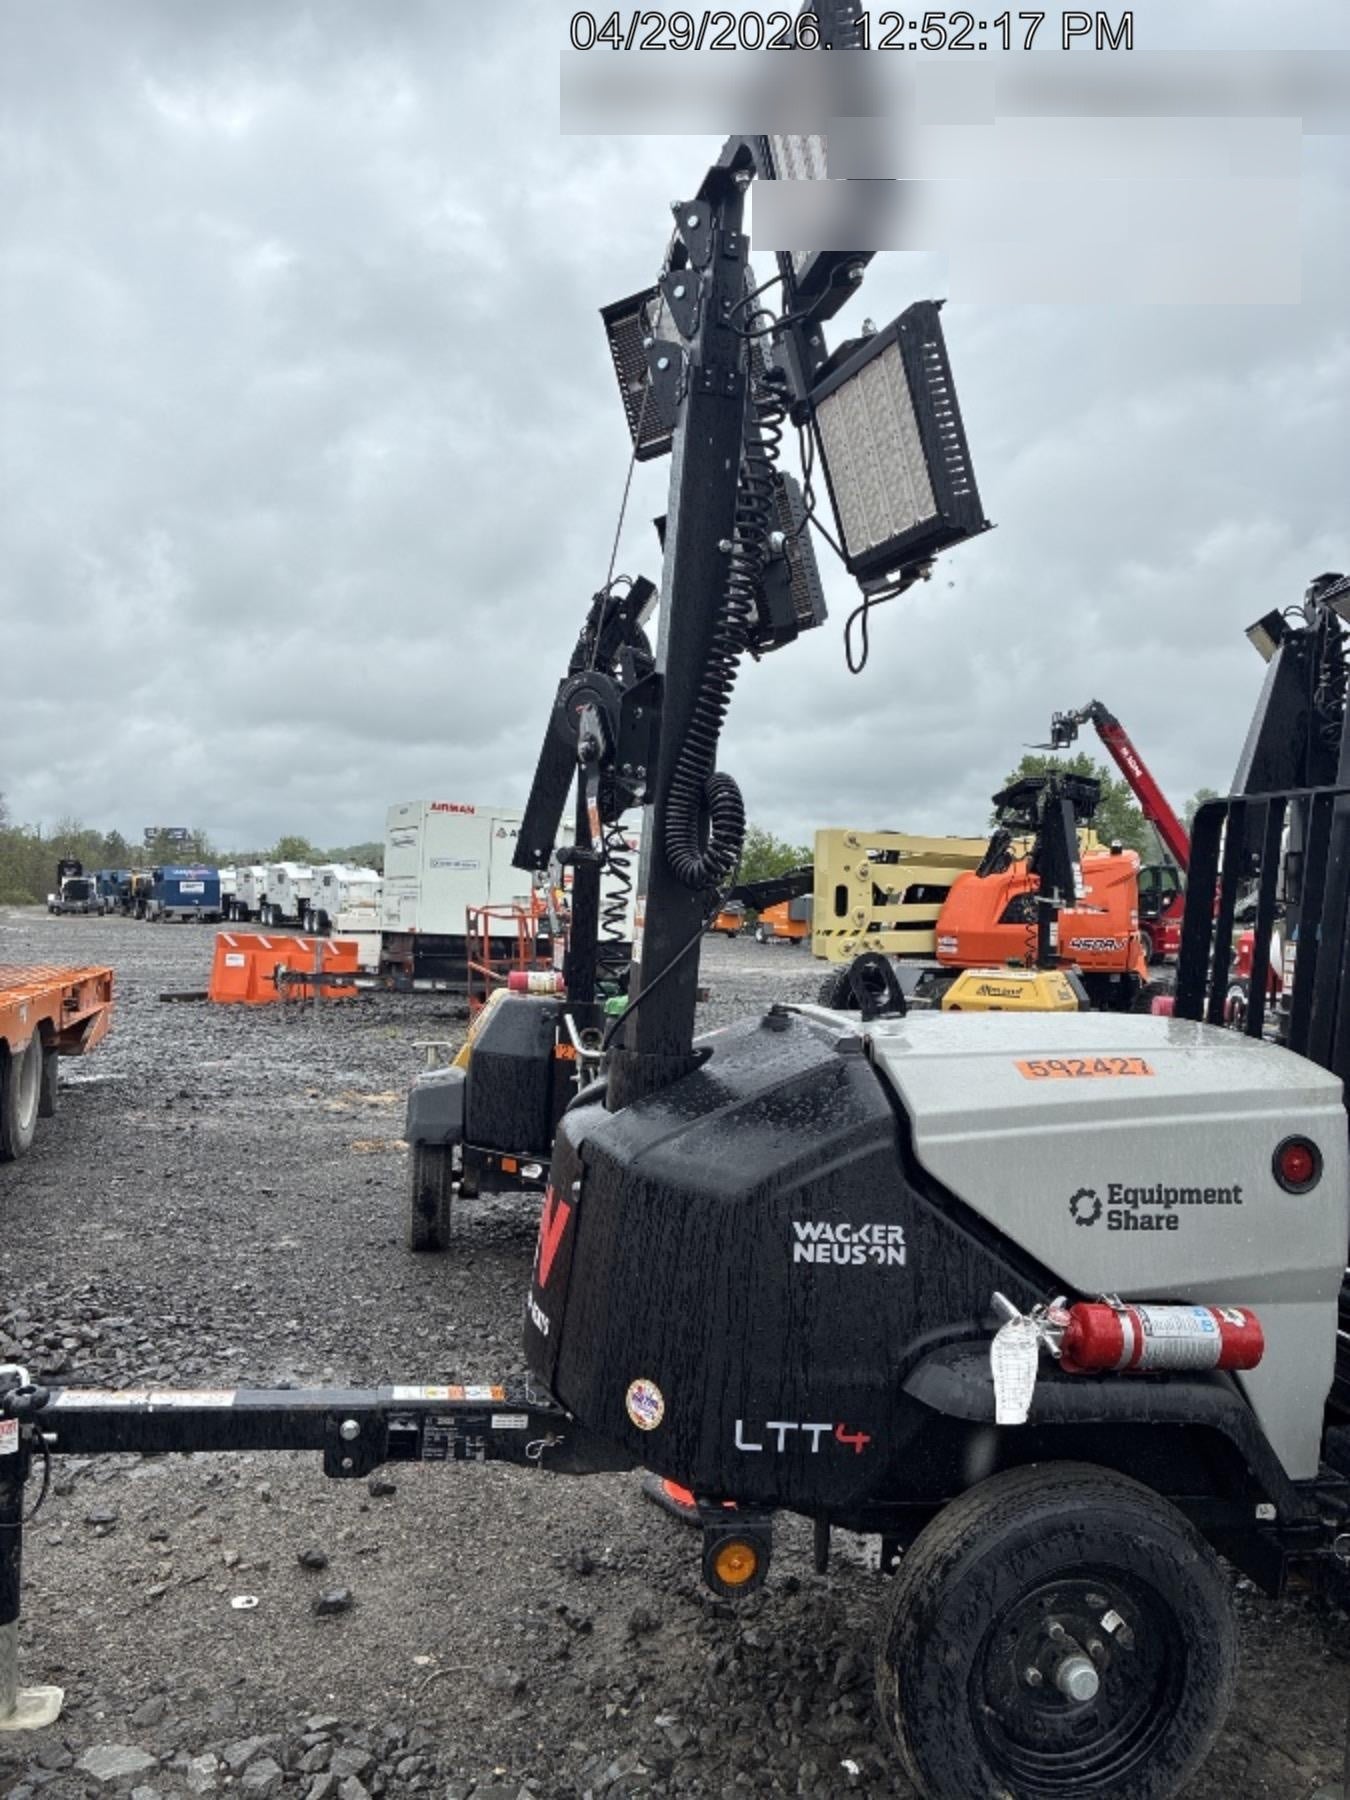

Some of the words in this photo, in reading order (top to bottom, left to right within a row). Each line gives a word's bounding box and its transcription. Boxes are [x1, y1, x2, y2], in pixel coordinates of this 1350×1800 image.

[430, 801, 476, 815] AIRMAN
[1026, 1057, 1151, 1077] 592427
[1107, 1183, 1243, 1209] Equipment
[1107, 1210, 1179, 1231] Share
[792, 1221, 906, 1245] WACKER
[792, 1242, 907, 1266] NEUSON
[734, 1419, 871, 1454] LTT4
